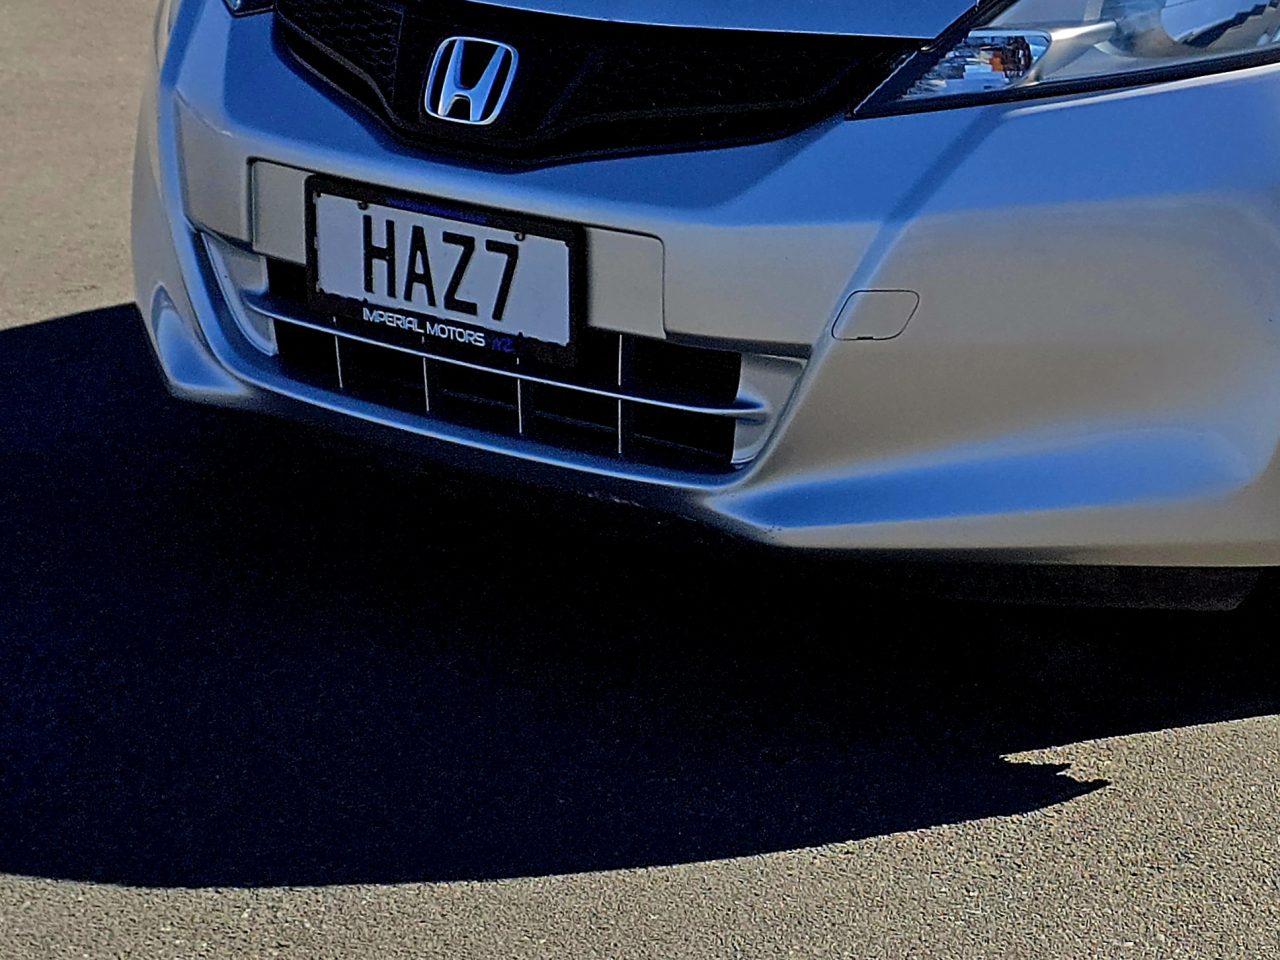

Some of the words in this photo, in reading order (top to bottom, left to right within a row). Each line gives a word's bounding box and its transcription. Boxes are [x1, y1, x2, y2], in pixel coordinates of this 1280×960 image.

[362, 214, 519, 321] HAZ7
[362, 306, 425, 334] IMPERIAL
[426, 320, 486, 347] MOTORS
